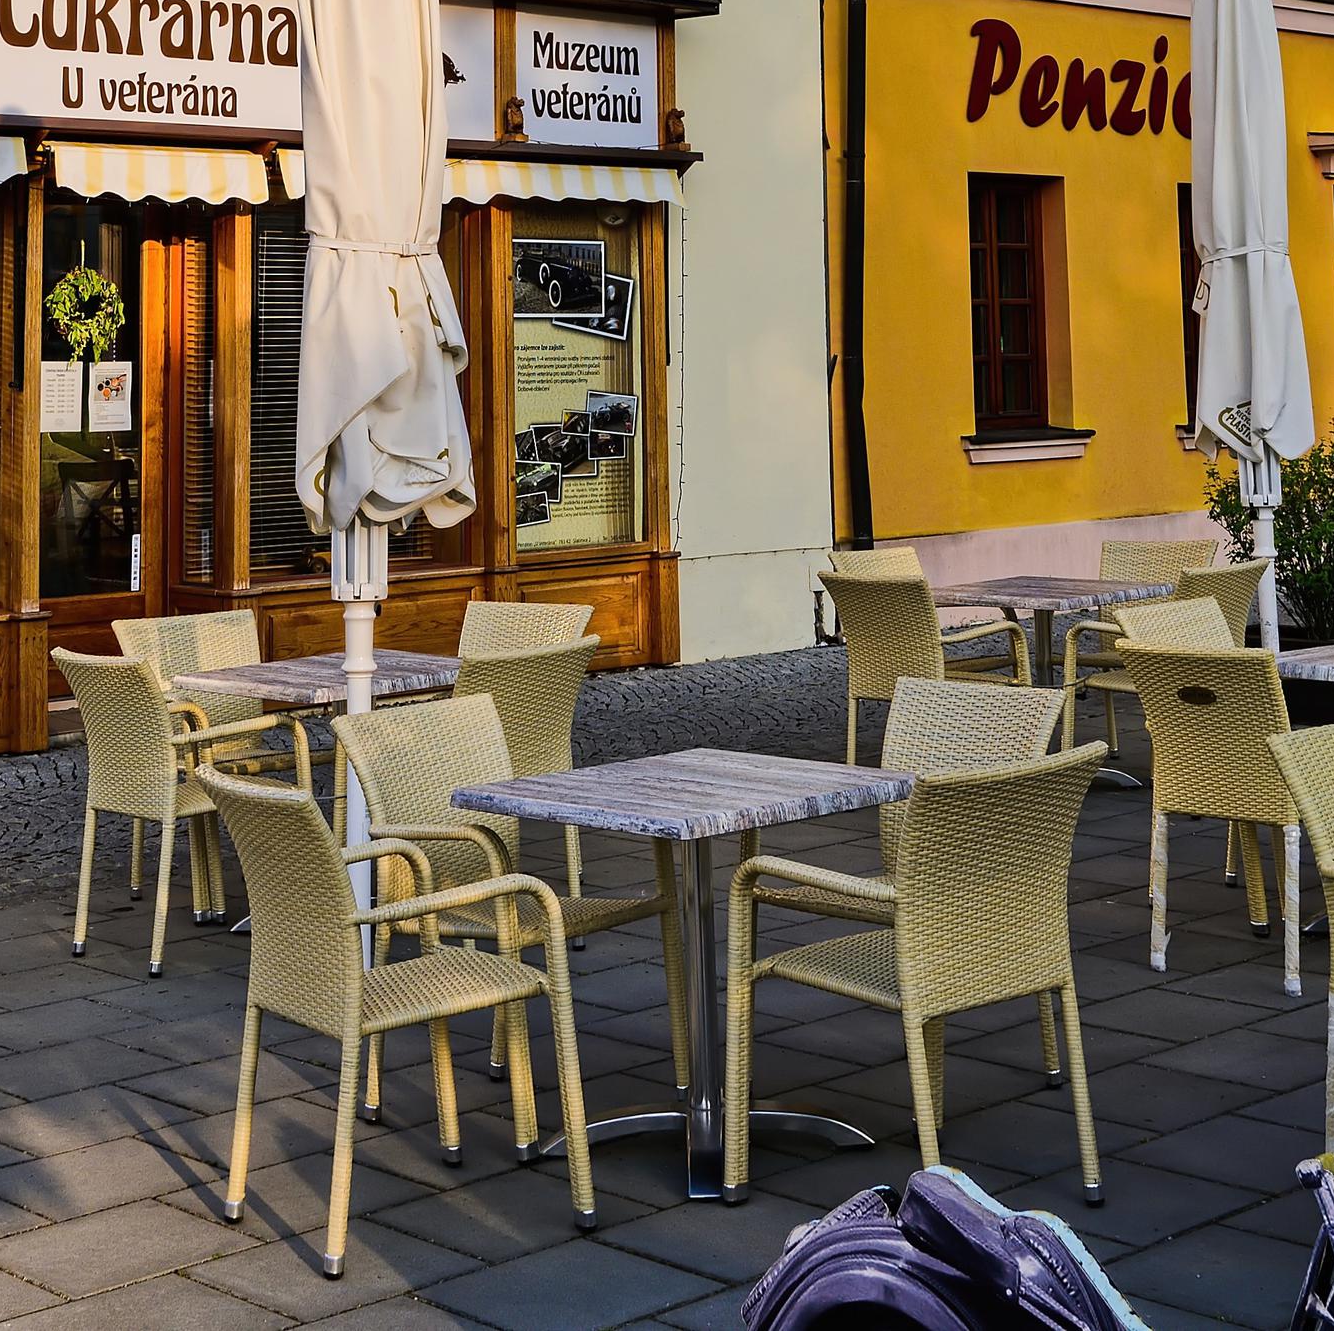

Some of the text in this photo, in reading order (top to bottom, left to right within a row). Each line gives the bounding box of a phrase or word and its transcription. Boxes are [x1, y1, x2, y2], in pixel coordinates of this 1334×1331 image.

[532, 30, 640, 77] Muzeum
[62, 66, 238, 119] U veterána
[531, 82, 642, 124] veteránů
